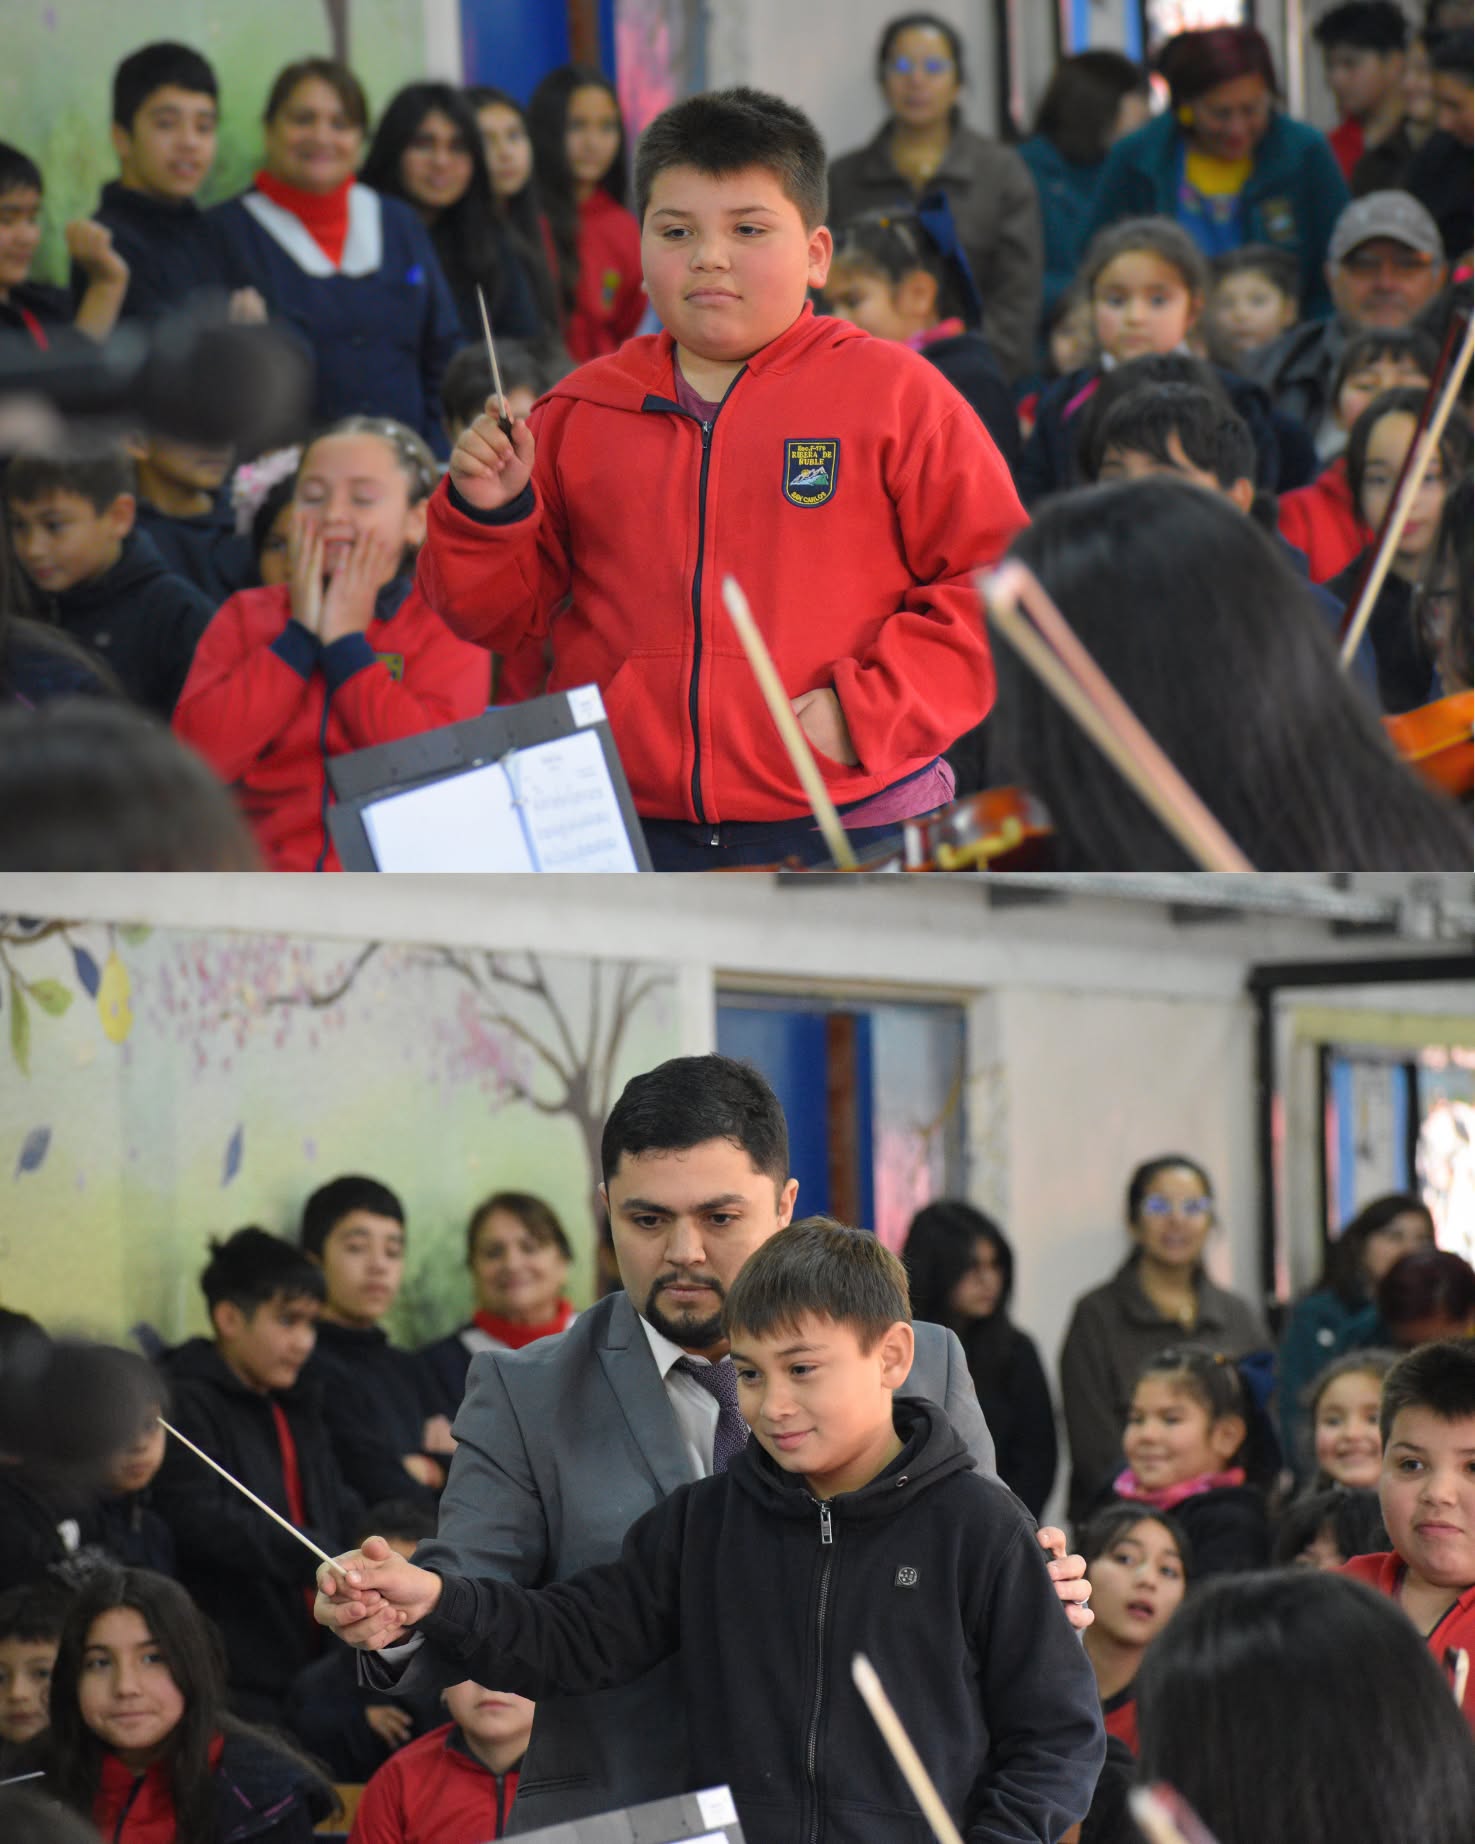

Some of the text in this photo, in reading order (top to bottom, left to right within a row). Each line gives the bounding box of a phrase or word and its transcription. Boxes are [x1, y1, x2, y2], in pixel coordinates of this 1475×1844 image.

[791, 451, 832, 459] RIBERA DE
[803, 491, 827, 503] CARLOS
